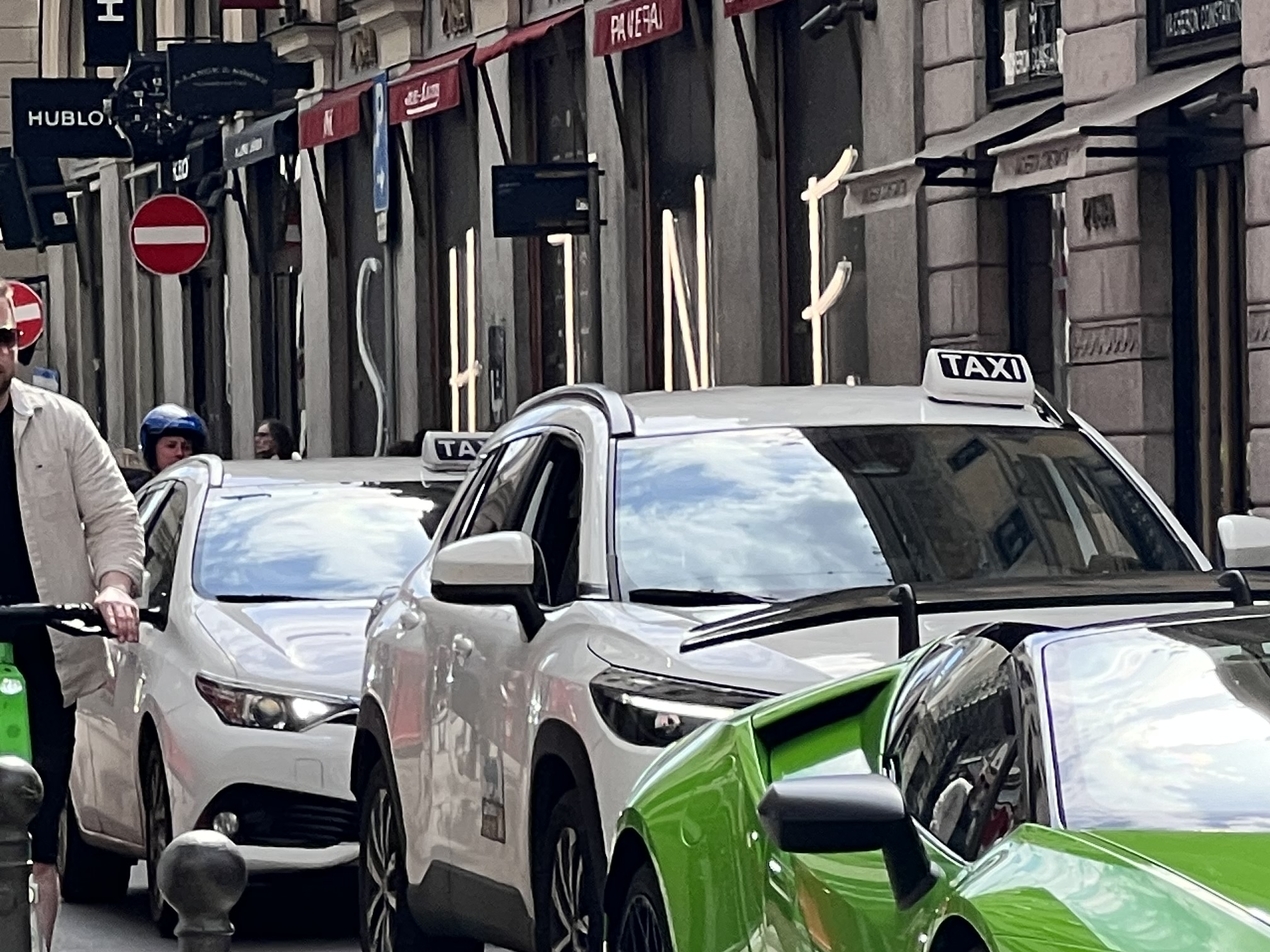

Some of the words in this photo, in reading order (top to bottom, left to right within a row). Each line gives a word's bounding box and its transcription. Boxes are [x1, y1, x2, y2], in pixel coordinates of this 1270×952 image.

[28, 110, 112, 126] HUBLO
[941, 354, 1021, 379] TAXI
[438, 441, 484, 457] TA
